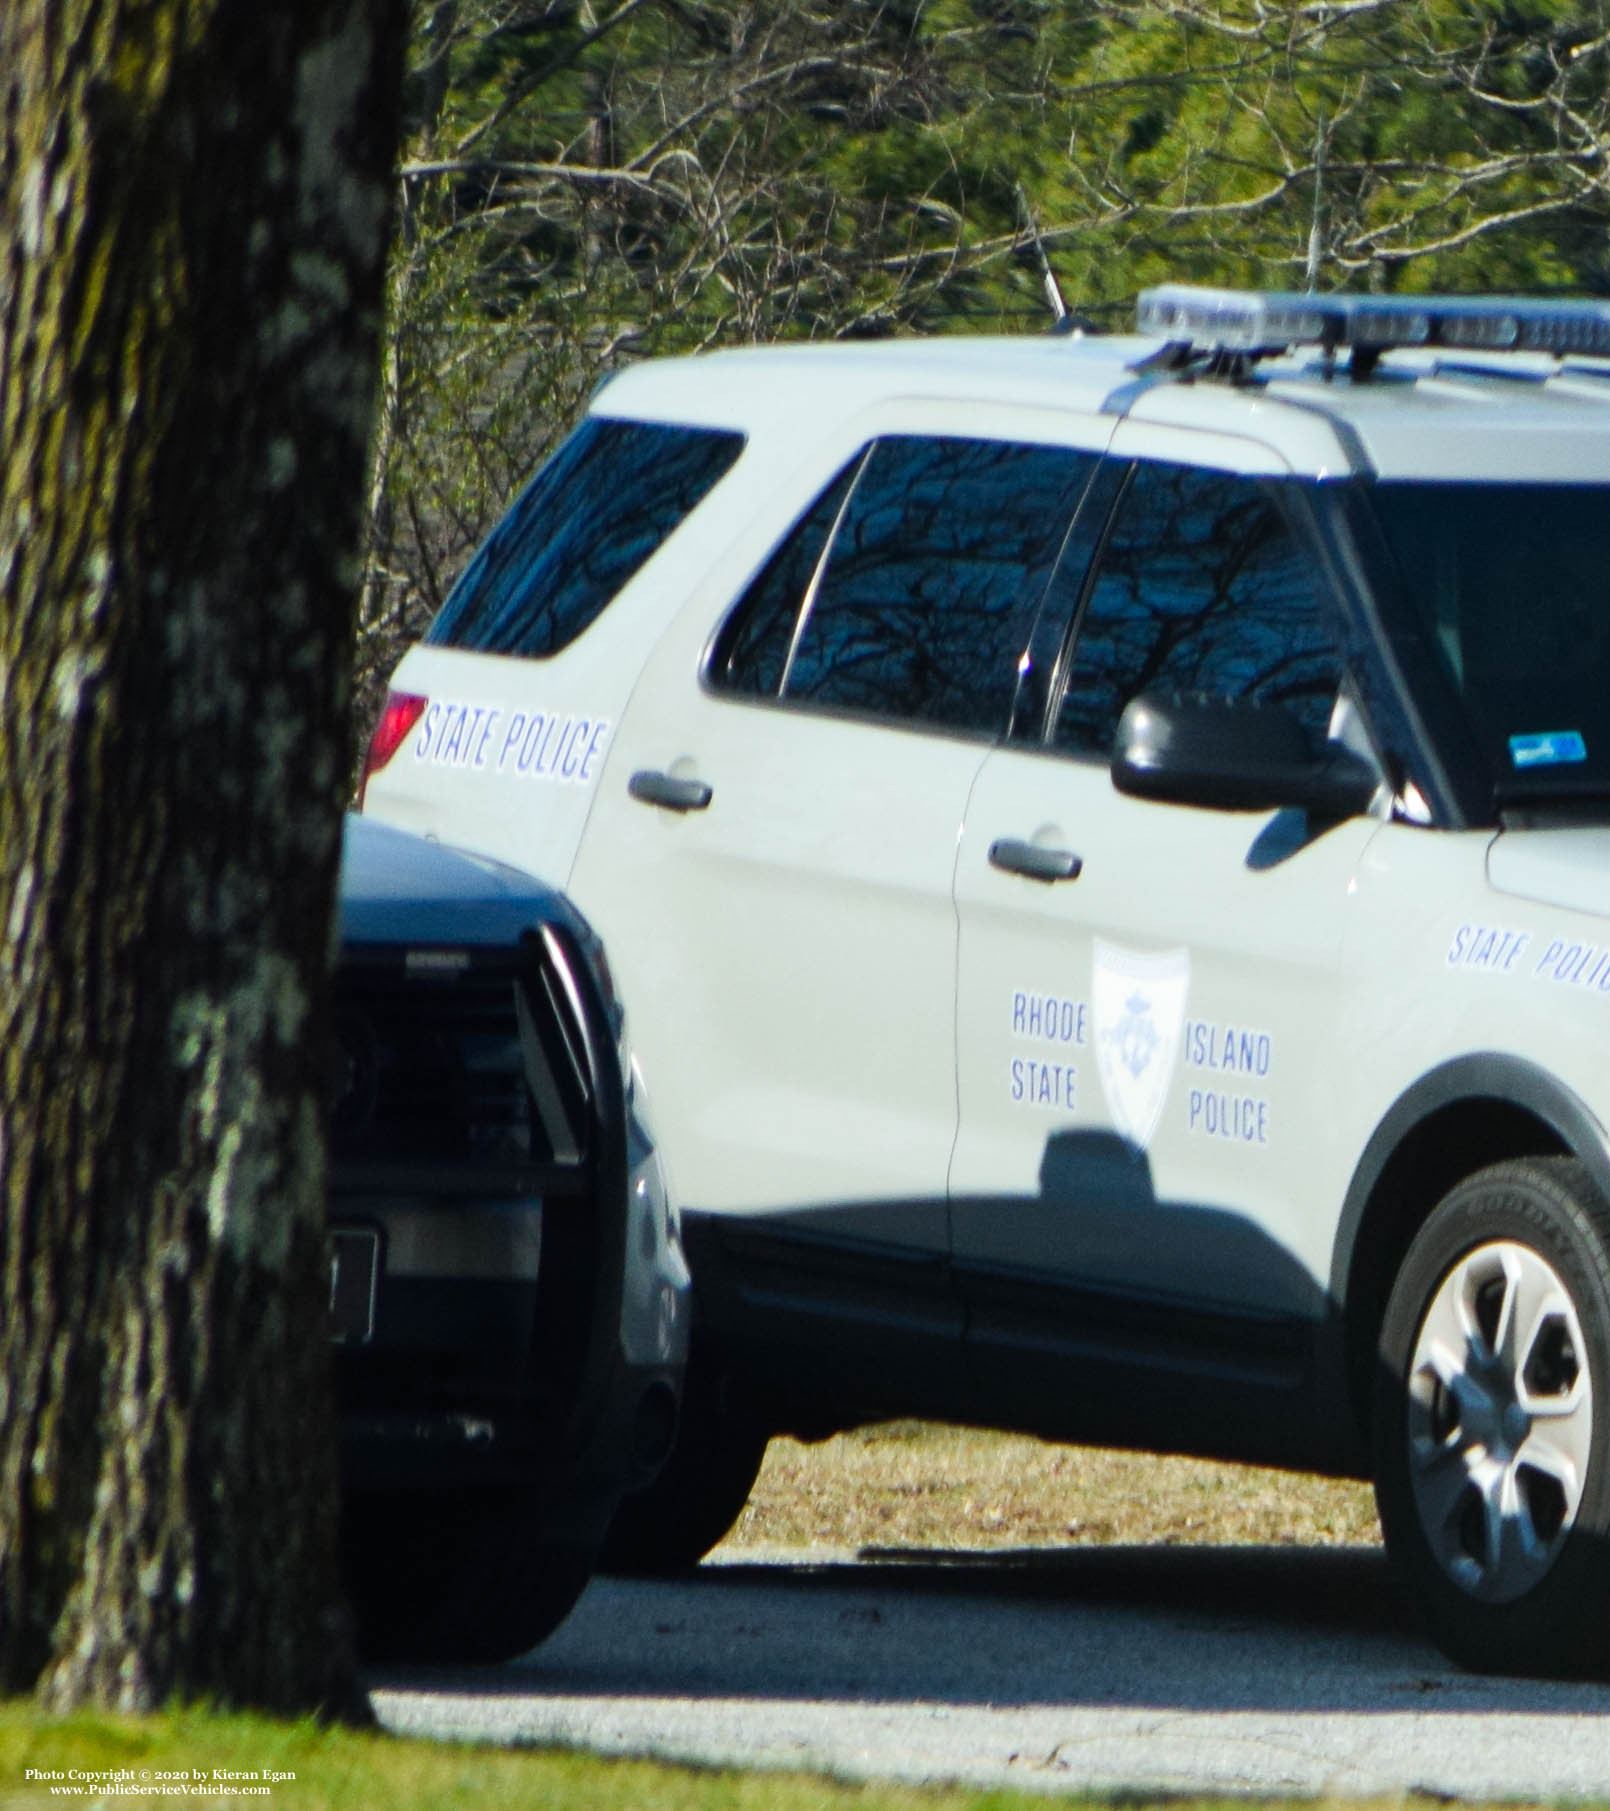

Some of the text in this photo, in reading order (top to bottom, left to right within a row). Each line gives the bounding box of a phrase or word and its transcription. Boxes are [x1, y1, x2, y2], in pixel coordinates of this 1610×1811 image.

[415, 702, 607, 779] STATE POLICE
[1447, 924, 1529, 969] STATE
[1012, 992, 1271, 1077] RHODE ISLAND
[1010, 1058, 1268, 1144] STATE POLICE
